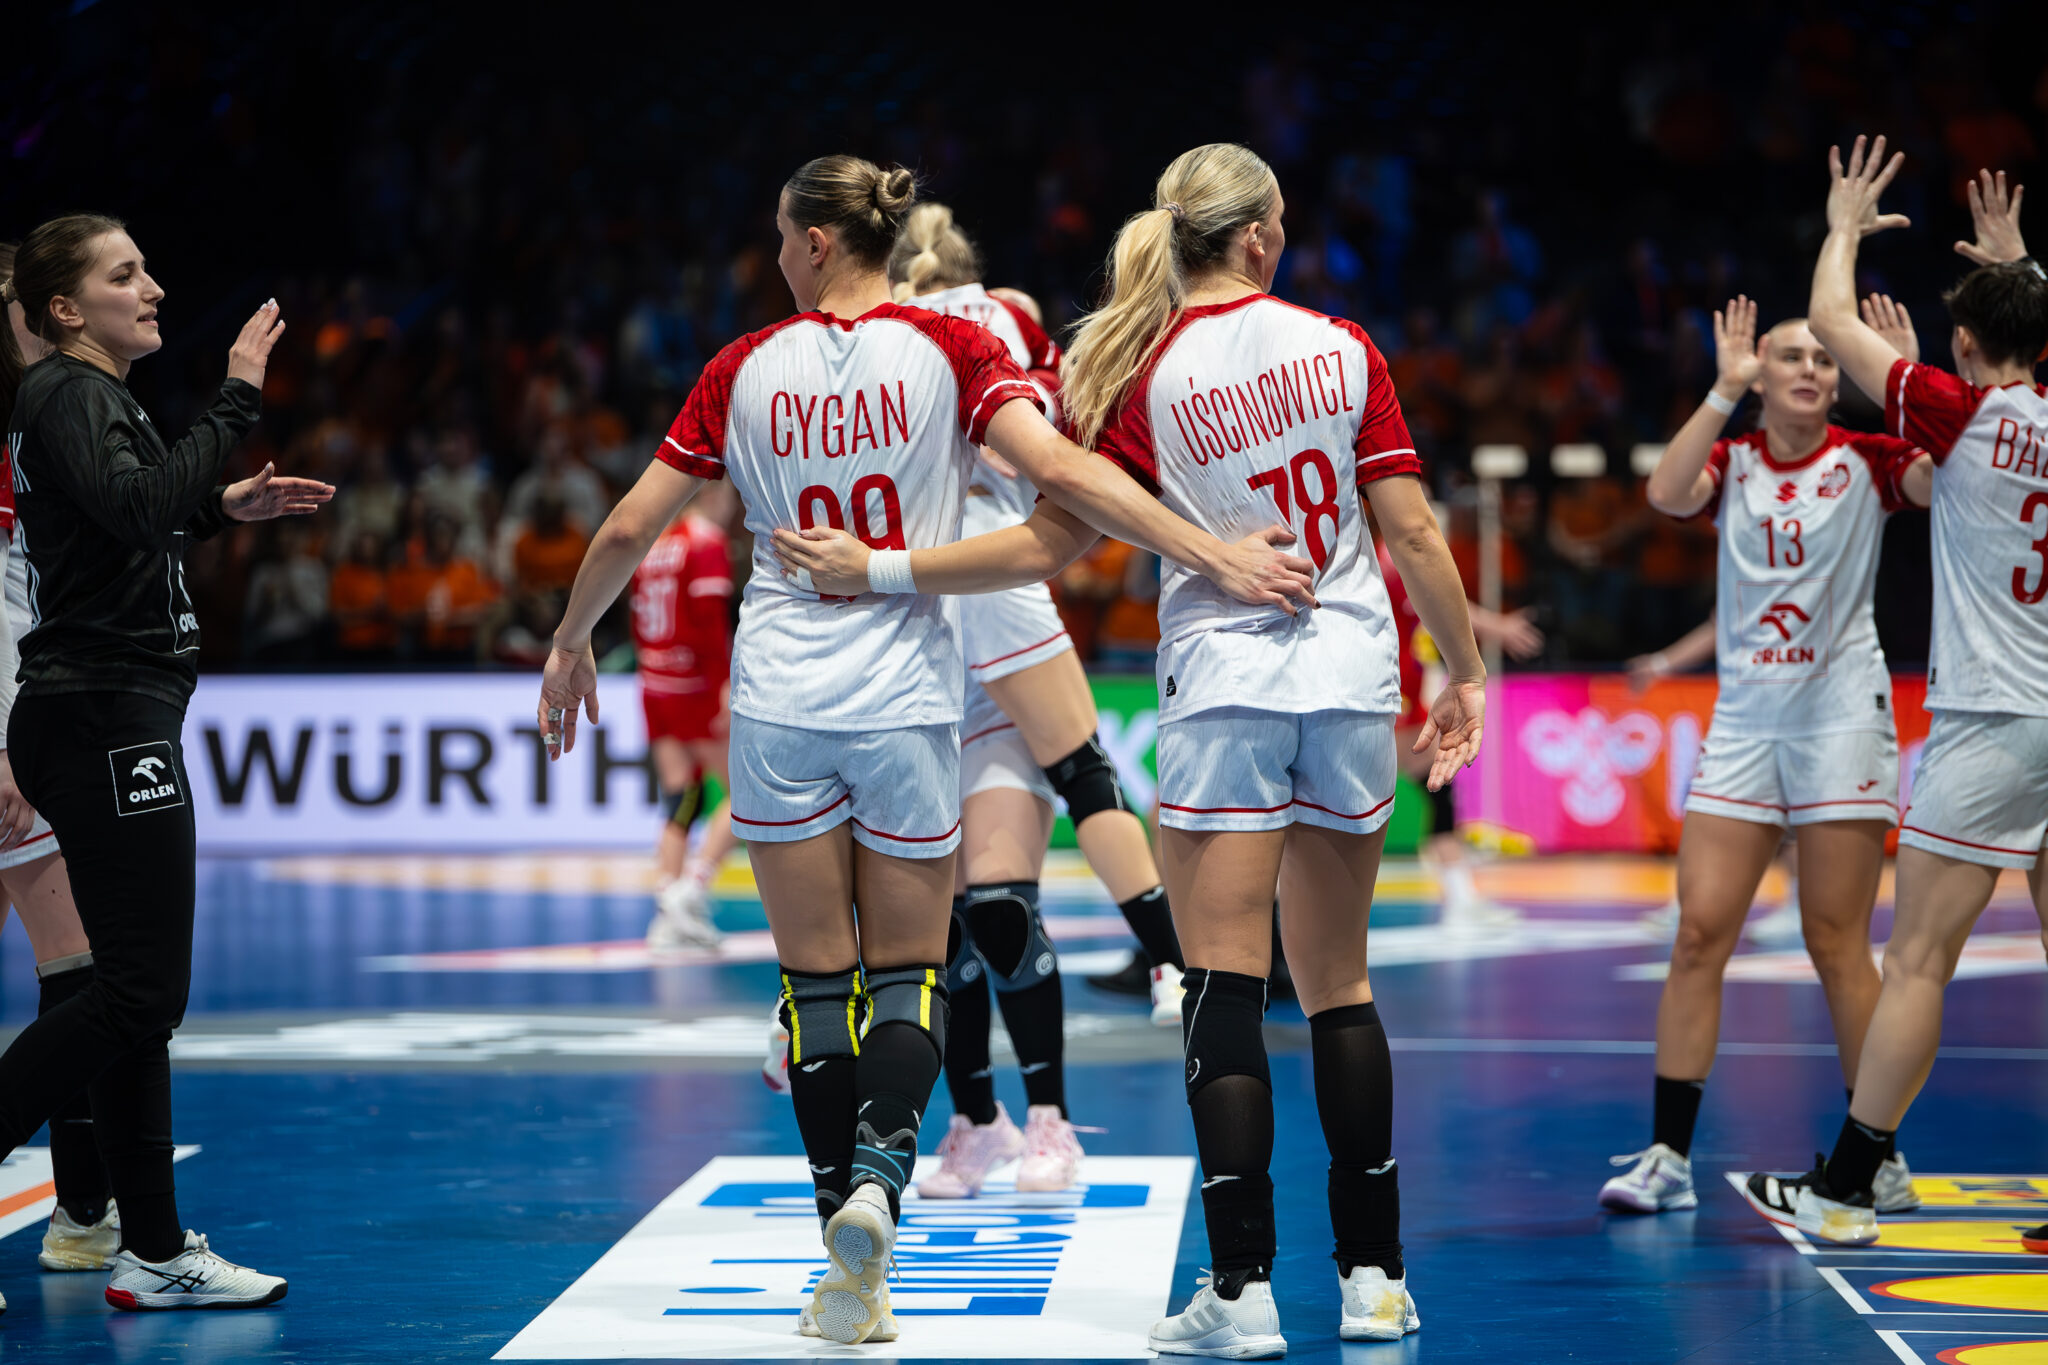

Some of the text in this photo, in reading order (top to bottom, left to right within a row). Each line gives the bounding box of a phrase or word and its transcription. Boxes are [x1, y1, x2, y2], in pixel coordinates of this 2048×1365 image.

[770, 380, 909, 459] CYGAN
[1171, 350, 1353, 466] UŚCINOWICZ
[1246, 449, 1339, 572] 78
[1760, 516, 1804, 568] 13
[1752, 647, 1815, 665] ORLEN
[129, 783, 176, 803] ORLEN
